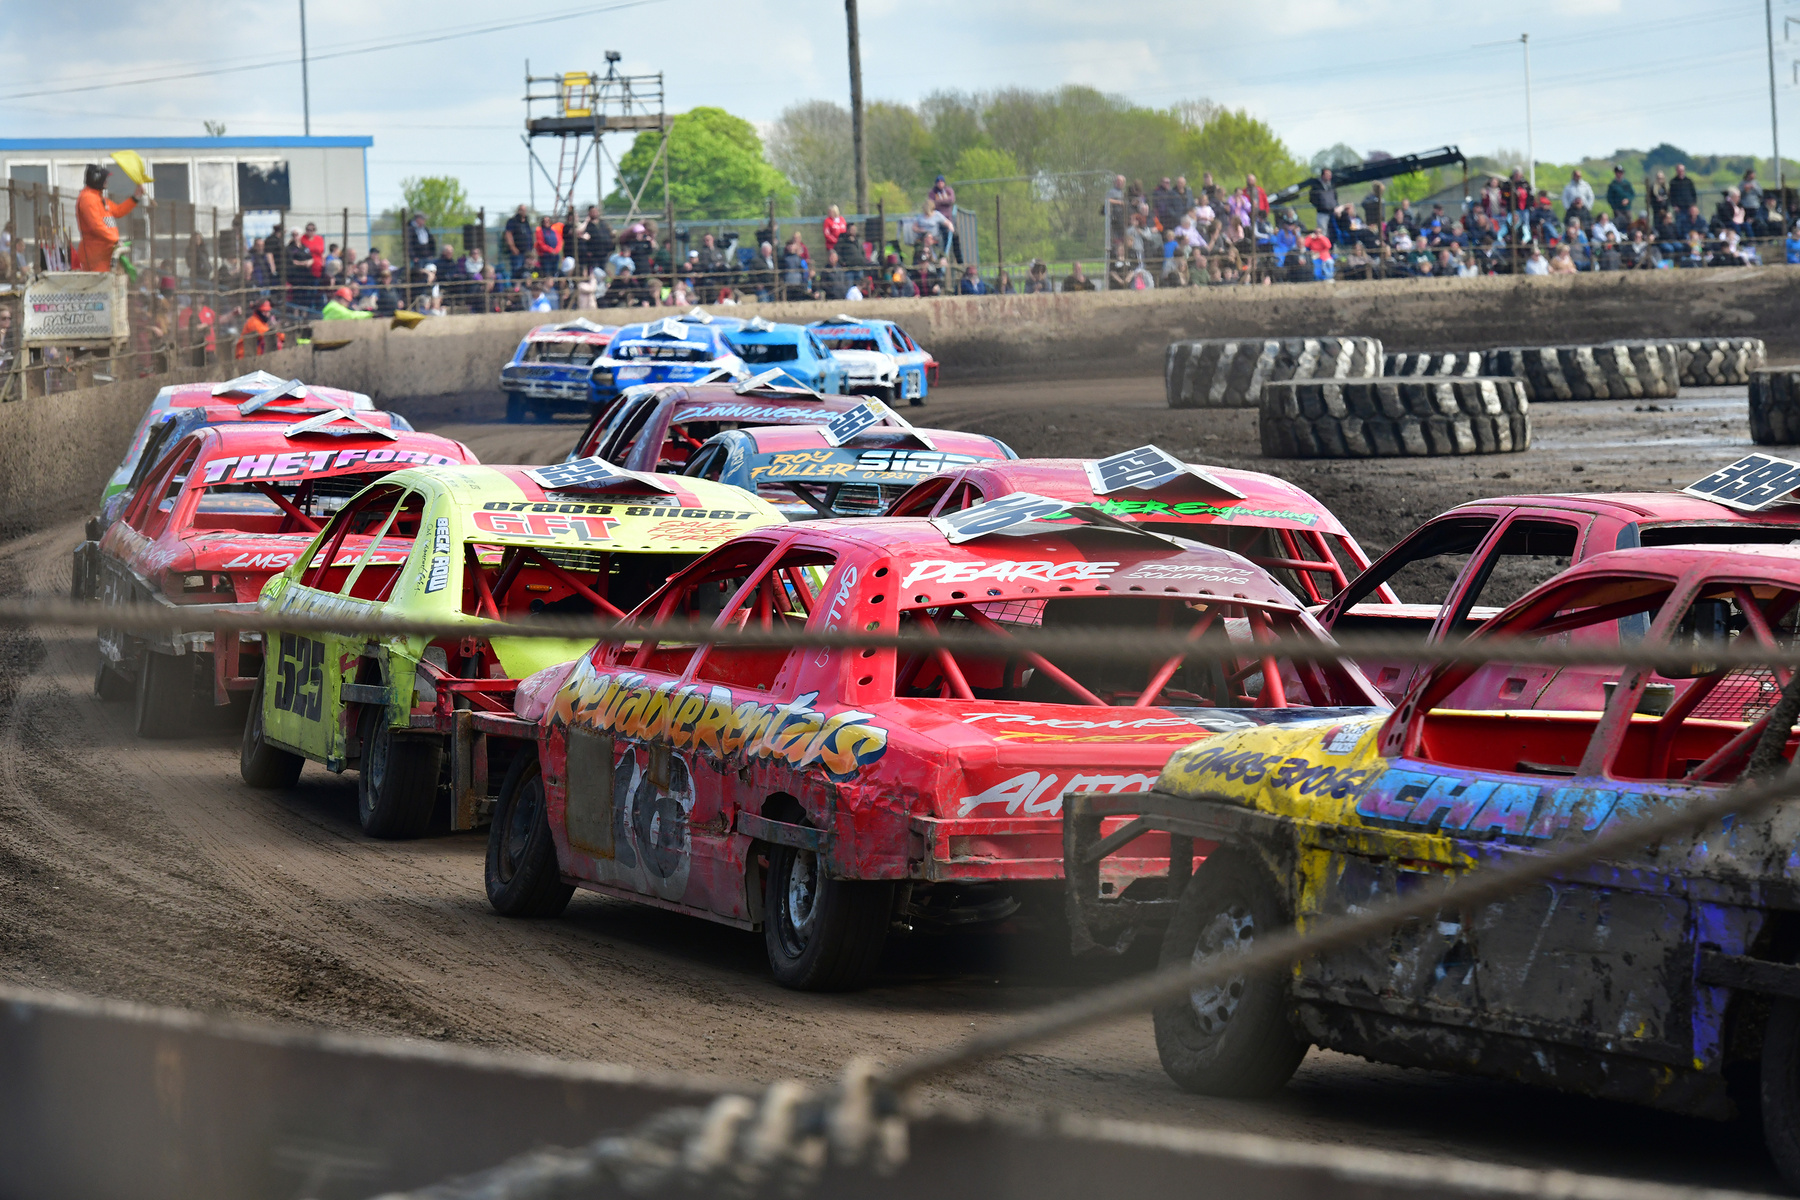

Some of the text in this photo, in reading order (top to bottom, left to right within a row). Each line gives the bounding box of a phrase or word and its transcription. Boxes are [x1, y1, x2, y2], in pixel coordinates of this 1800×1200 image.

[33, 302, 104, 312] TRACKSTAR
[43, 313, 94, 327] RACING
[673, 405, 840, 422] CUNNINGHA
[828, 403, 877, 443] 561
[202, 448, 463, 484] THETFORD
[773, 451, 835, 464] ROY
[535, 456, 614, 486] 525
[751, 463, 857, 479] FULLER
[863, 471, 913, 480] 07931
[1097, 447, 1177, 491] 120
[1689, 455, 1800, 506] 399
[483, 502, 758, 520] 07808 811667
[472, 511, 622, 541] GFT
[648, 527, 743, 536] FORCE
[658, 521, 738, 529] GALE
[222, 552, 294, 569] LMS
[425, 517, 450, 594] BECK ROW
[902, 560, 1120, 589] PEARCE
[1123, 572, 1249, 584] SOLUTIONS
[1137, 564, 1254, 576] PROPERTY
[274, 631, 325, 722] 525
[1184, 746, 1283, 785] 01495
